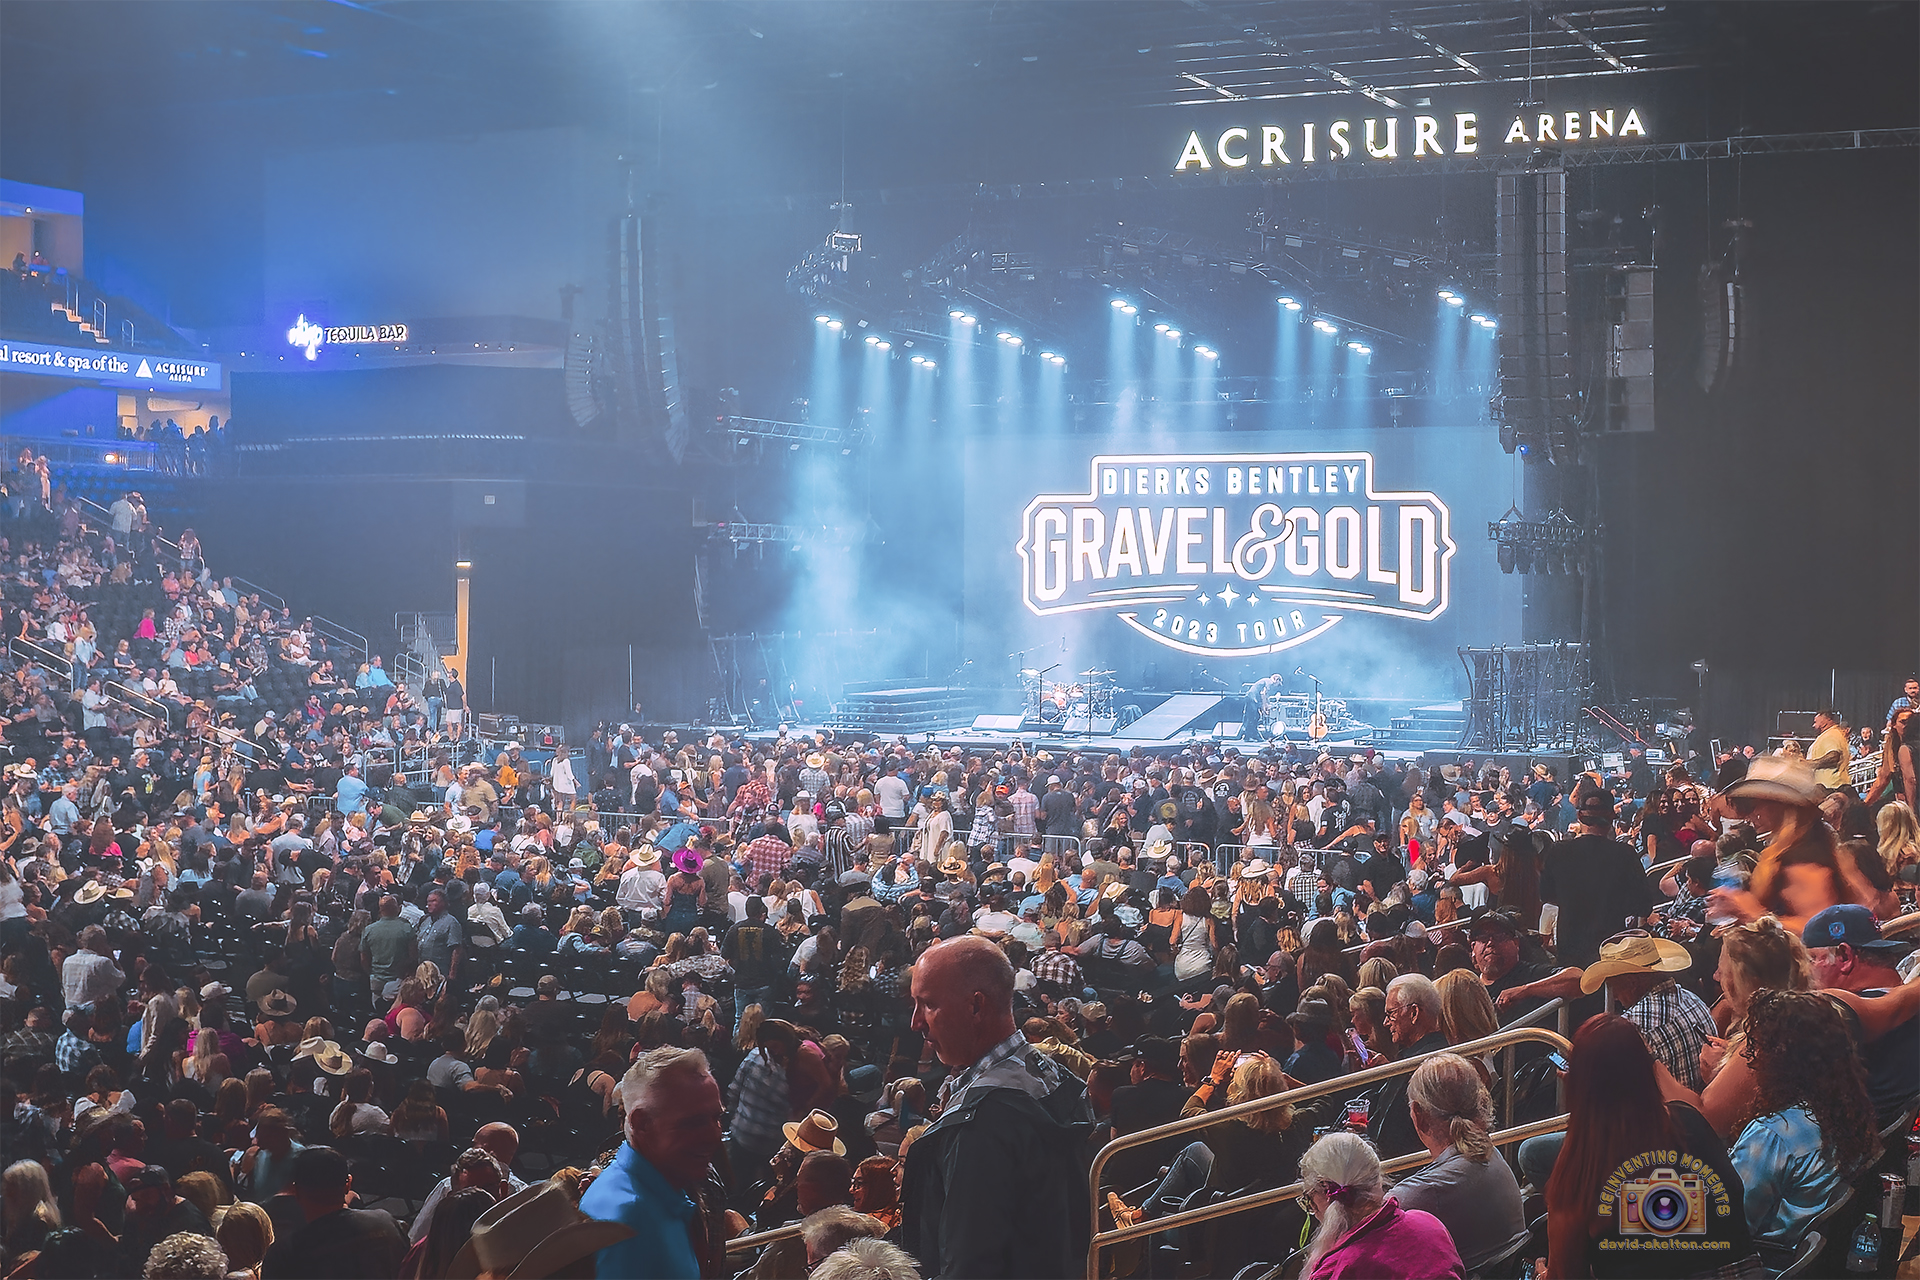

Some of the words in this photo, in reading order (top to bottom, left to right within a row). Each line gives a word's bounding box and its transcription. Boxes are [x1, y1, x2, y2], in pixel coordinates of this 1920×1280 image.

[1174, 111, 1480, 171] ACRISURE
[1504, 107, 1647, 144] ARENA
[324, 325, 379, 343] TEQUILA
[379, 324, 408, 342] BAR
[12, 350, 51, 366] resort
[53, 351, 66, 367] &
[68, 356, 91, 372] spa
[92, 355, 108, 371] of
[107, 356, 129, 373] the
[155, 362, 208, 377] ACRISURE
[1102, 467, 1210, 496] DIERKS
[1227, 465, 1361, 495] BENTLEY
[1152, 607, 1219, 643] 2023
[1237, 609, 1307, 643] TOUR
